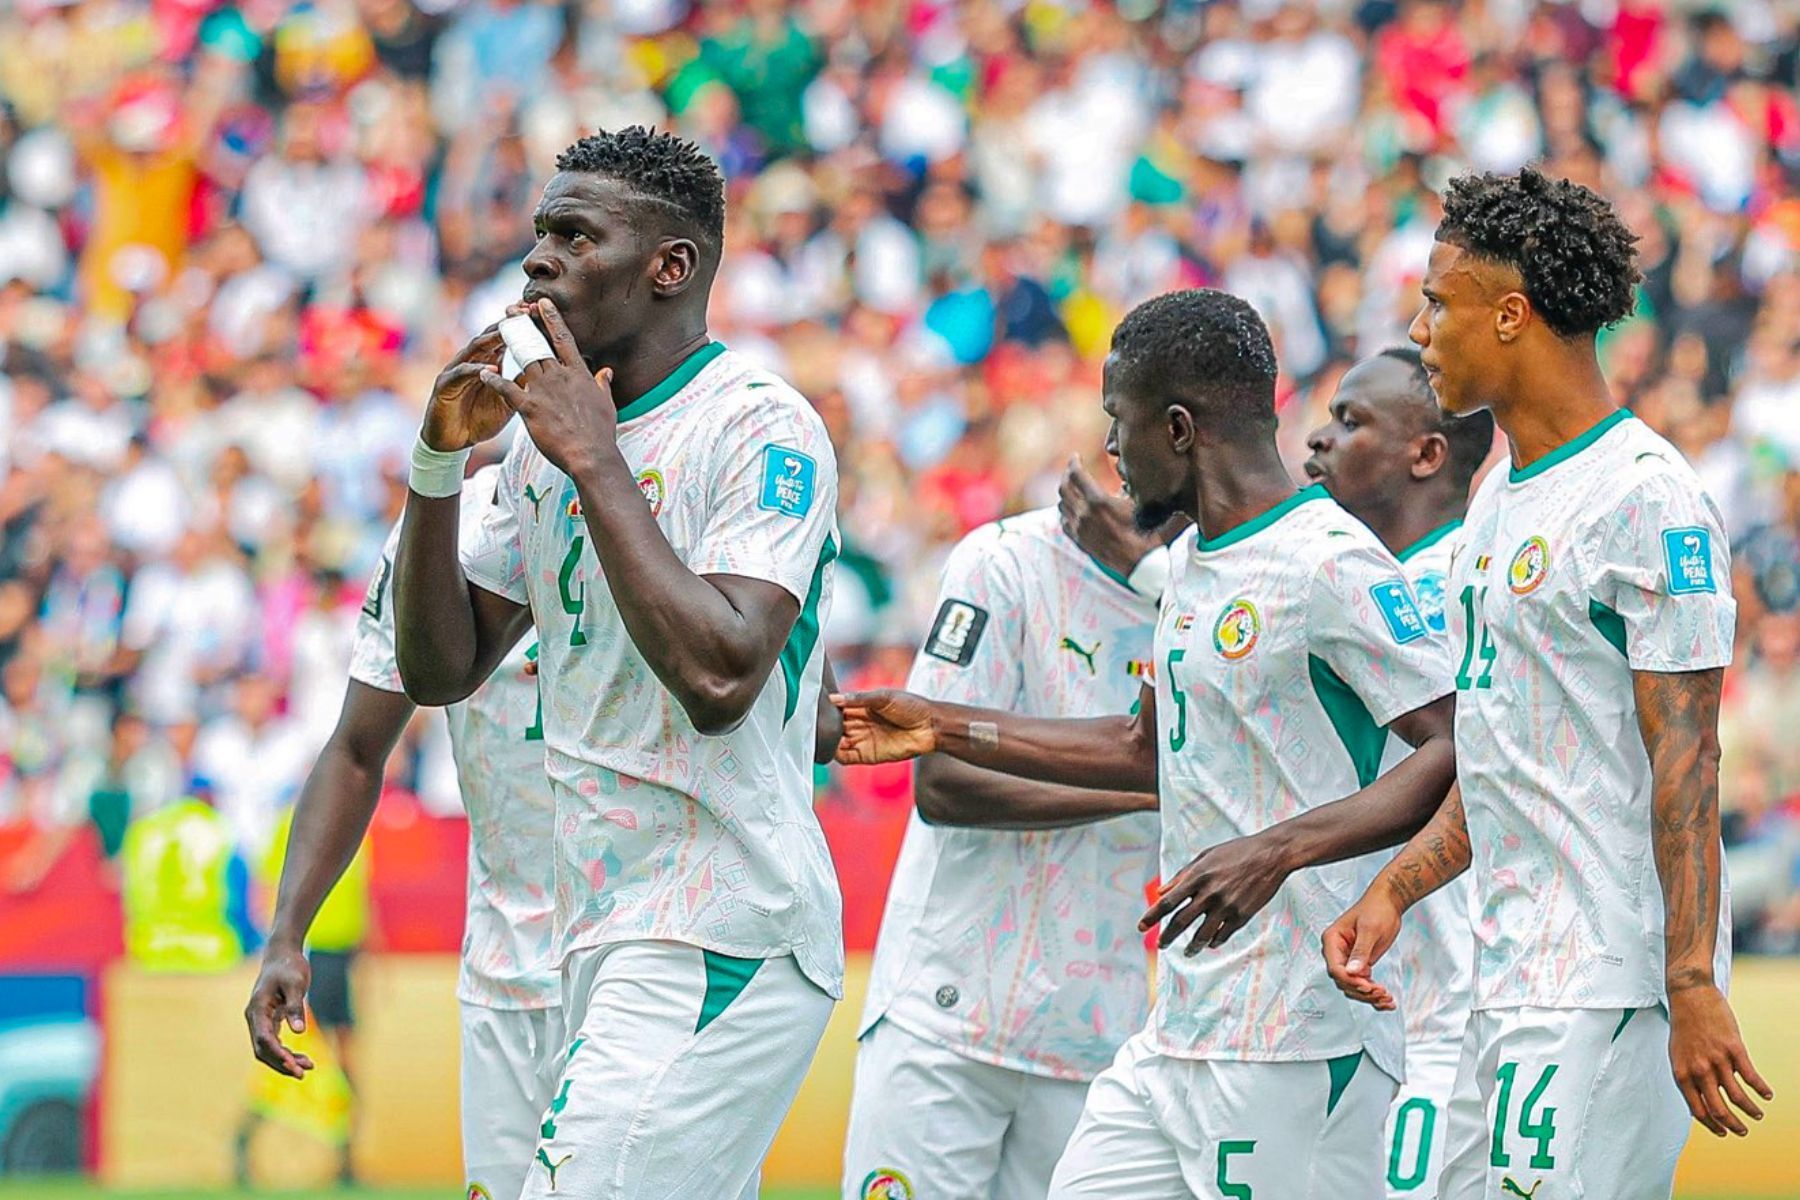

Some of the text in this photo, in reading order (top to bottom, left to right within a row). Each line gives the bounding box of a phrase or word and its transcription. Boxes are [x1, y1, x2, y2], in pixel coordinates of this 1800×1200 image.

[1455, 585, 1497, 690] 14
[1167, 649, 1187, 753] 5
[1490, 1062, 1560, 1170] 14
[1217, 1140, 1257, 1200] 5
